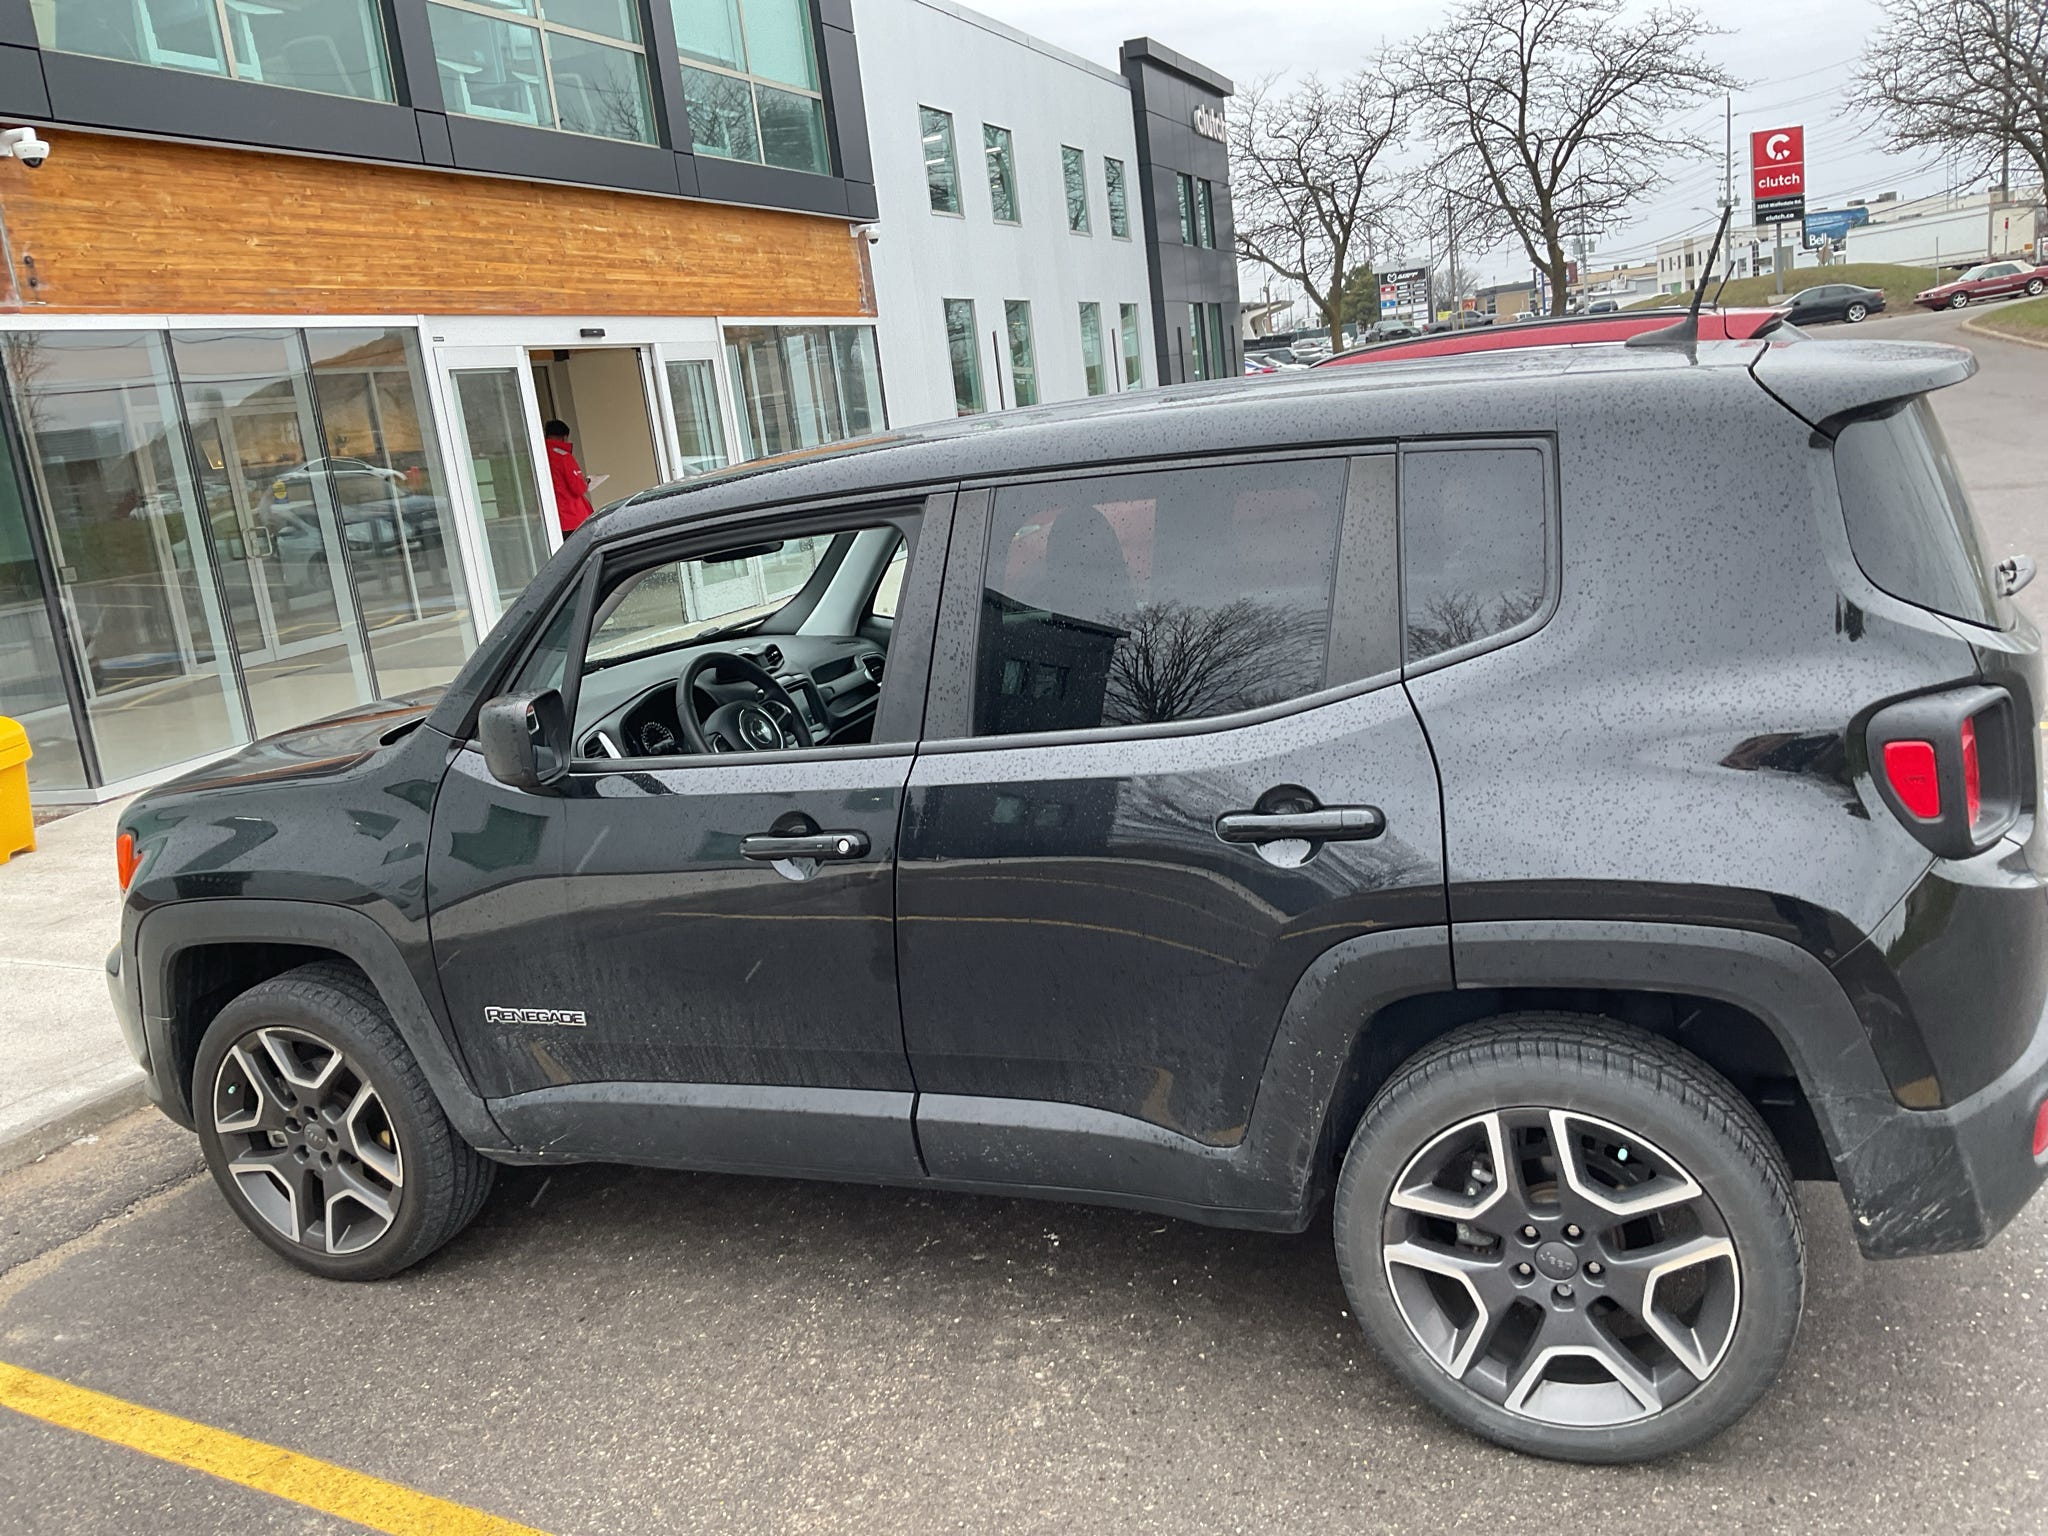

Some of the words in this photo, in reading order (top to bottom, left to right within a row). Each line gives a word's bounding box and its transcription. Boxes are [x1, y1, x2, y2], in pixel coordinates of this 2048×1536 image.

[1194, 104, 1227, 143] clutch
[1758, 173, 1800, 189] clutch
[1765, 213, 1795, 222] clutch.ca
[1809, 232, 1827, 246] Bell
[484, 1006, 587, 1026] RENEGADE
